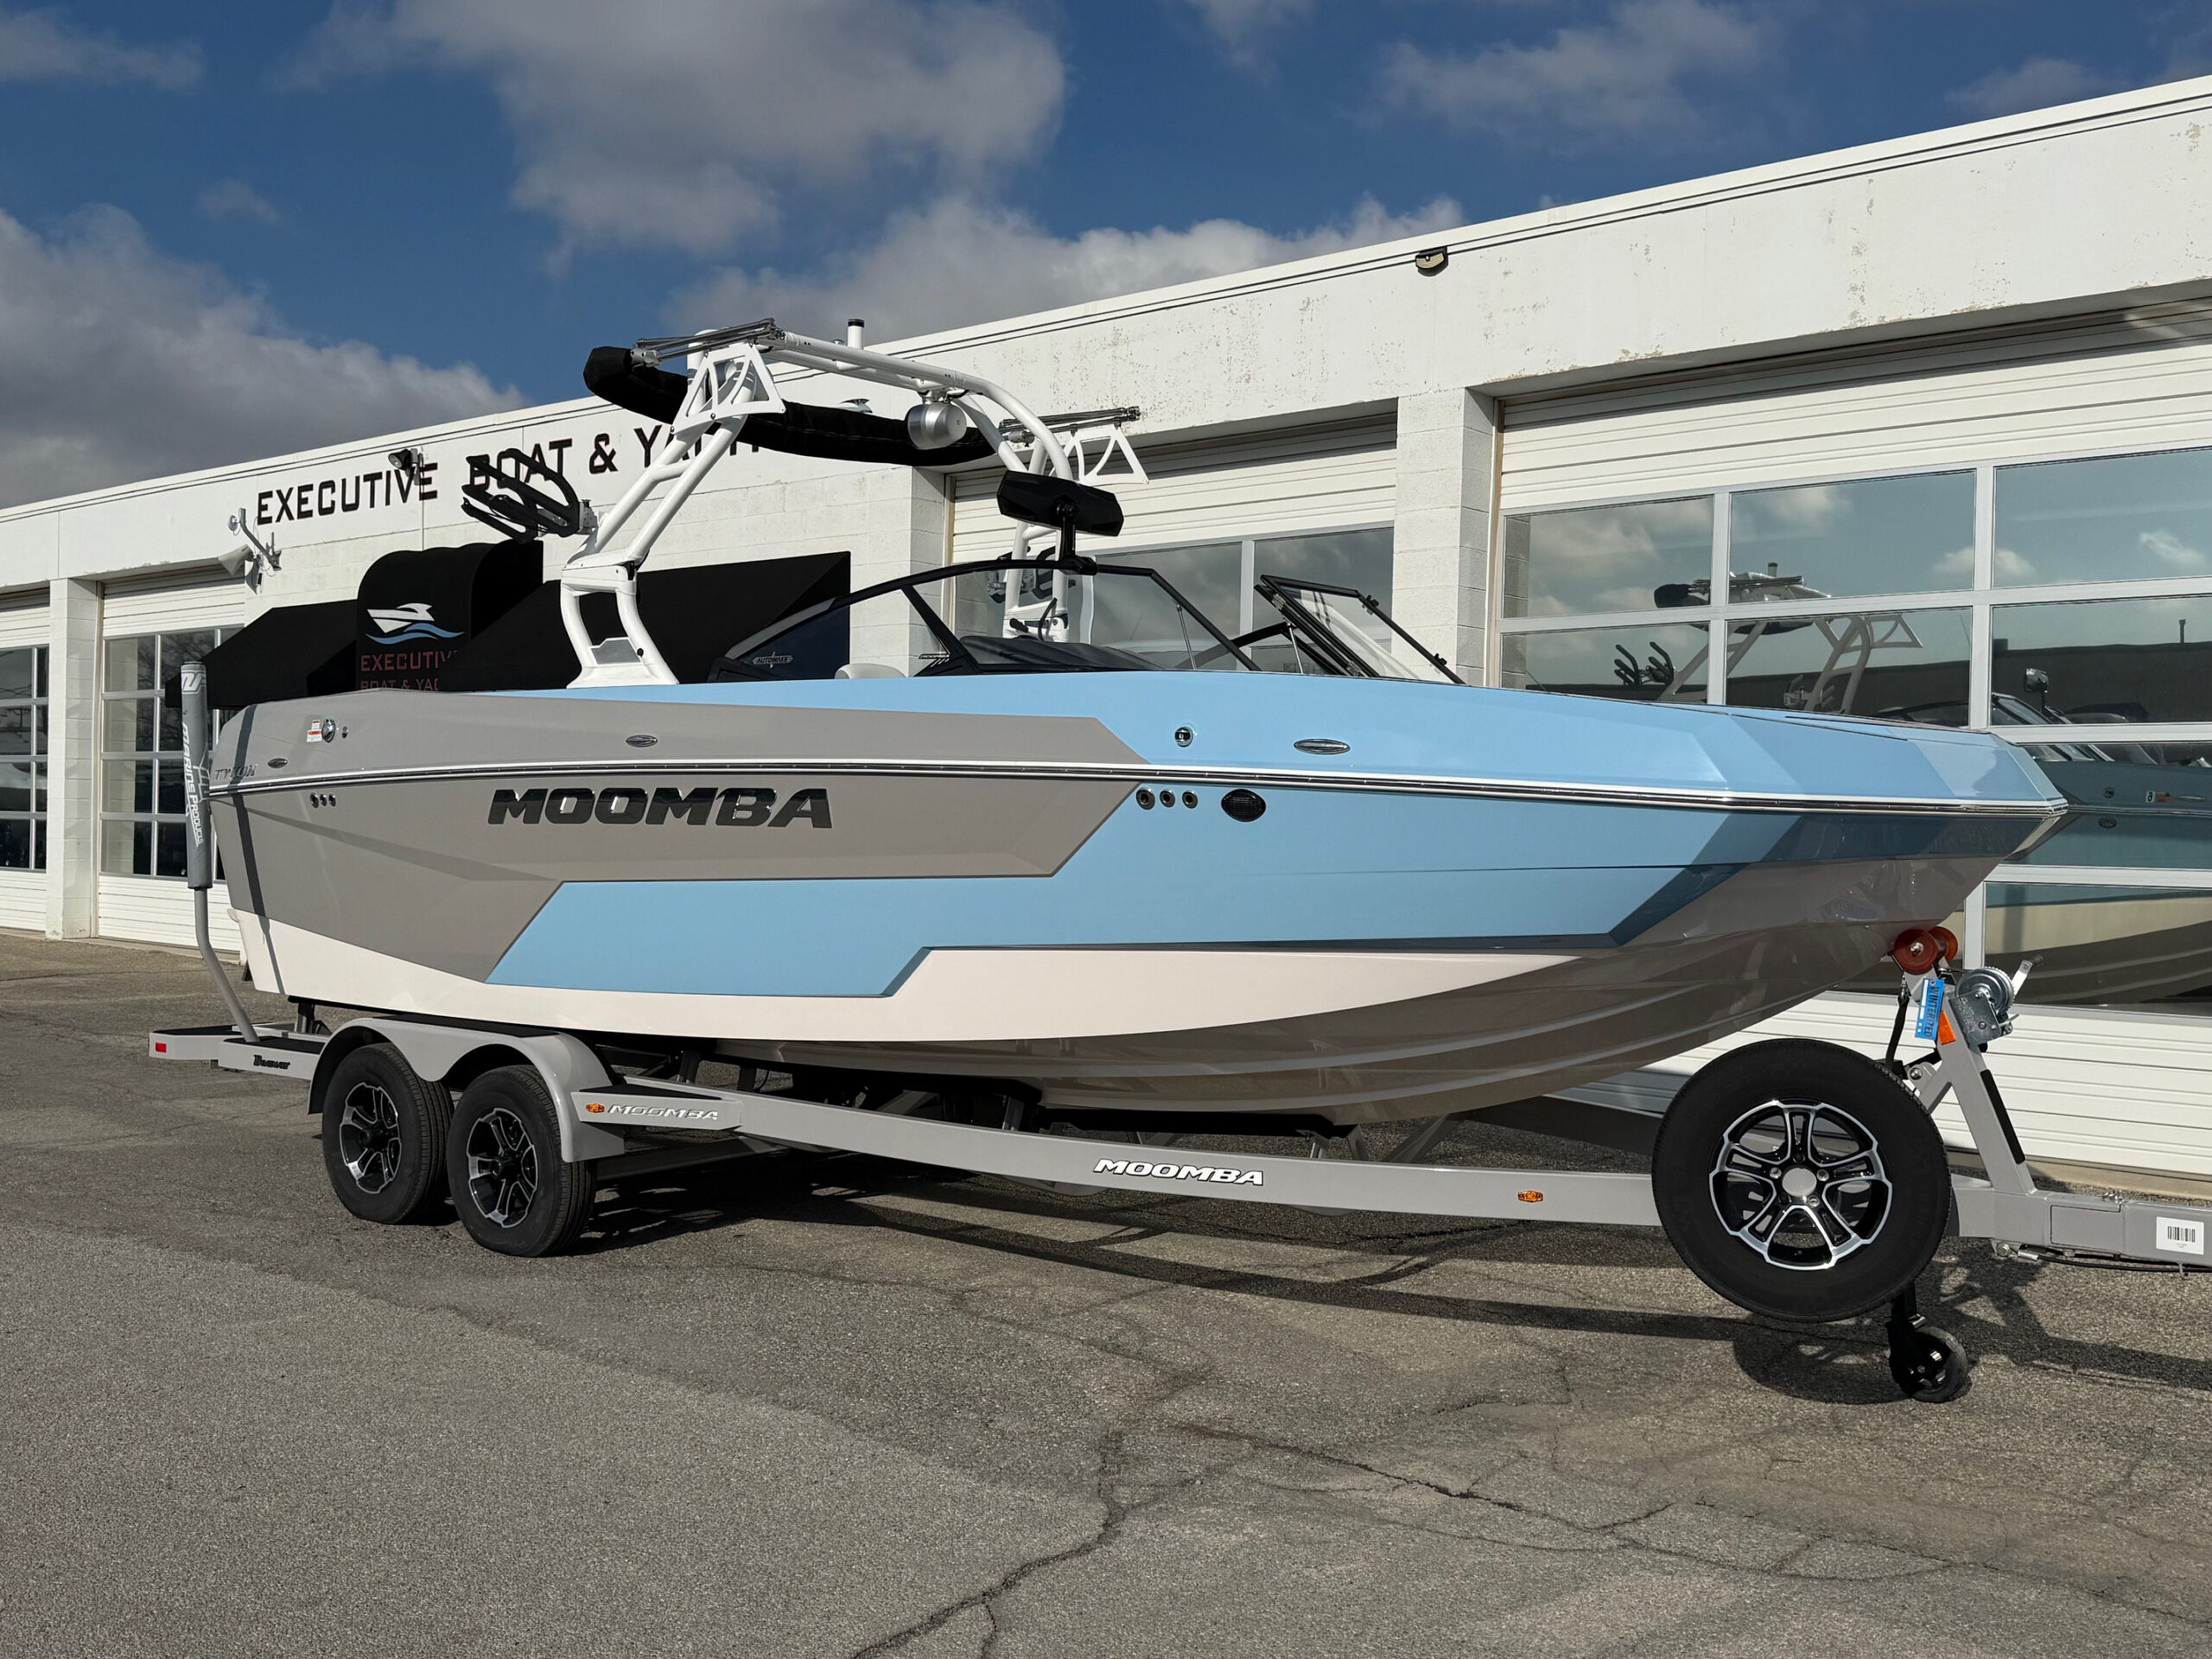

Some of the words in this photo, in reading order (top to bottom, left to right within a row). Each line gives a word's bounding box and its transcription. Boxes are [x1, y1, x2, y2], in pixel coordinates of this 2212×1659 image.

[257, 461, 438, 525] EXECUTIVE
[588, 433, 618, 474] &
[360, 650, 458, 671] EXECUTIV
[402, 678, 411, 690] &
[487, 787, 833, 829] MOOMBA
[1924, 986, 1939, 1037] WINTERIZED
[607, 1104, 718, 1121] MOOMBA
[1093, 1158, 1264, 1186] MOOMBA
